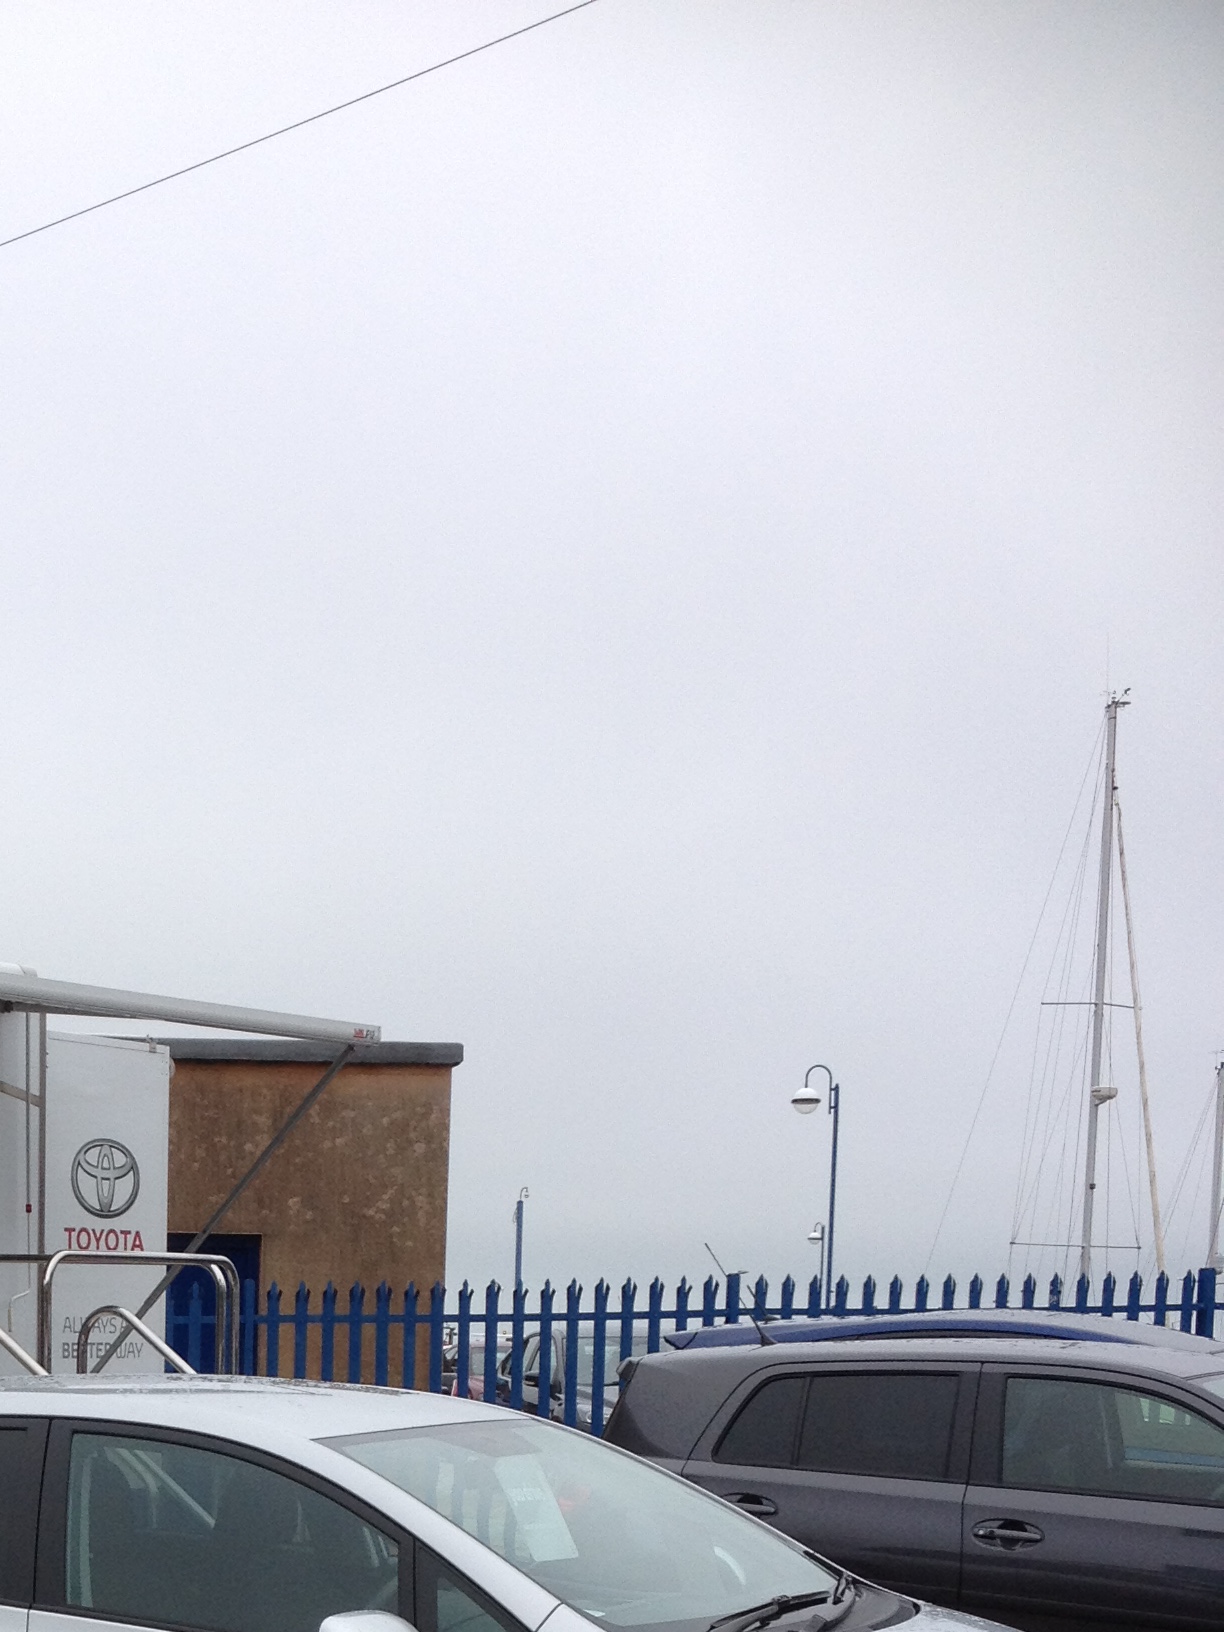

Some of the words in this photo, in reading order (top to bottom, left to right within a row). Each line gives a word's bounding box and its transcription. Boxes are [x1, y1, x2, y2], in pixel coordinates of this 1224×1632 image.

[64, 1227, 144, 1251] TOYOTA
[63, 1316, 117, 1334] ALAYS
[62, 1342, 114, 1359] BETER
[116, 1342, 143, 1359] WAY
